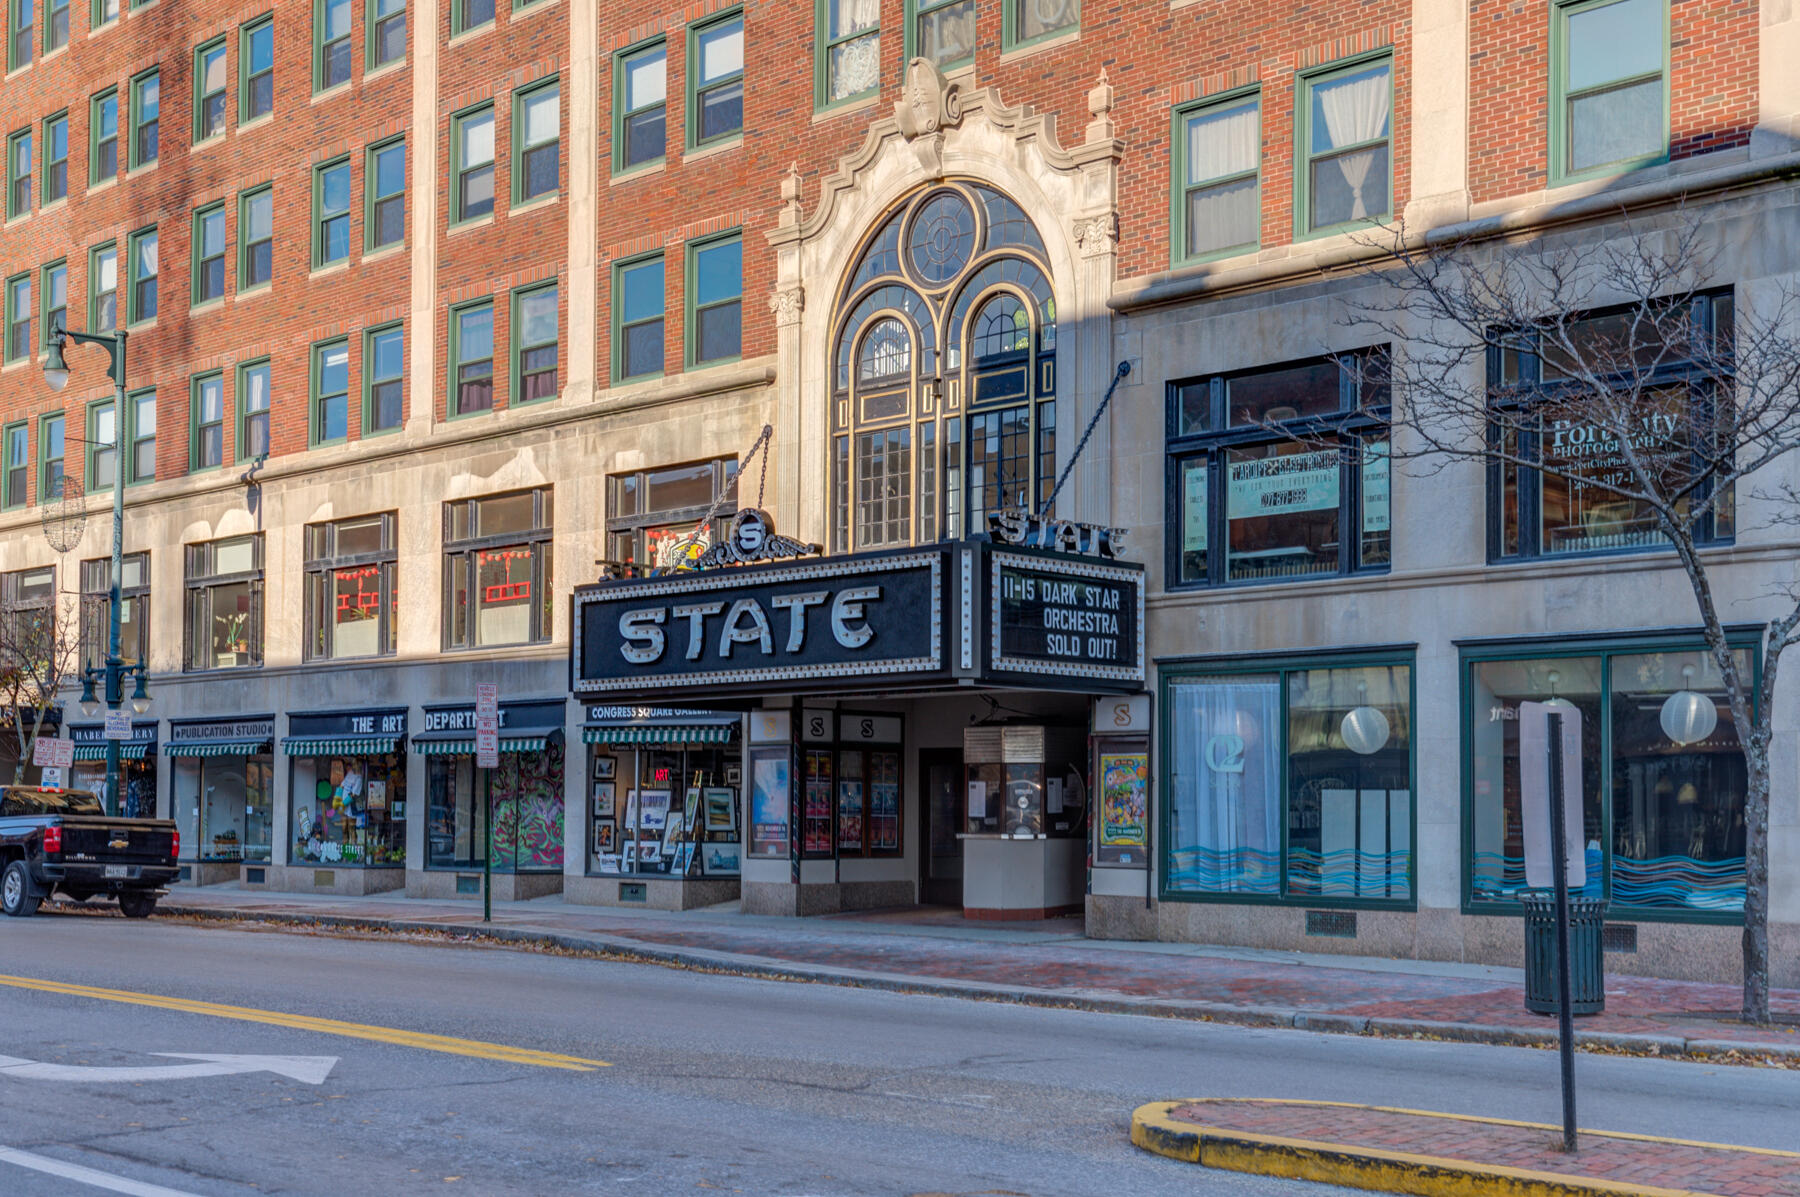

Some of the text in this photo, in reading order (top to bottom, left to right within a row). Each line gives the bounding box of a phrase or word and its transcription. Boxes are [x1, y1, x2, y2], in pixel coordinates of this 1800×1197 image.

[1619, 408, 1678, 440] ity
[1553, 435, 1668, 457] PHOTOGAPH
[739, 522, 762, 549] S
[994, 511, 1130, 559] STATE
[1003, 576, 1119, 610] 11-15 DARK STAR
[619, 585, 881, 664] STATE
[1043, 608, 1119, 635] ORCHESTRA
[1047, 633, 1117, 660] SOLD OUT!
[425, 710, 506, 730] DEPARTT
[592, 706, 636, 719] CONGRESS
[638, 707, 673, 718] SQUARE
[75, 728, 154, 741] HABEERY
[181, 723, 267, 738] PUBLICATION STUDIO
[351, 715, 404, 733] THE ART
[810, 717, 824, 736] S
[861, 719, 874, 738] S
[655, 769, 669, 782] ART
